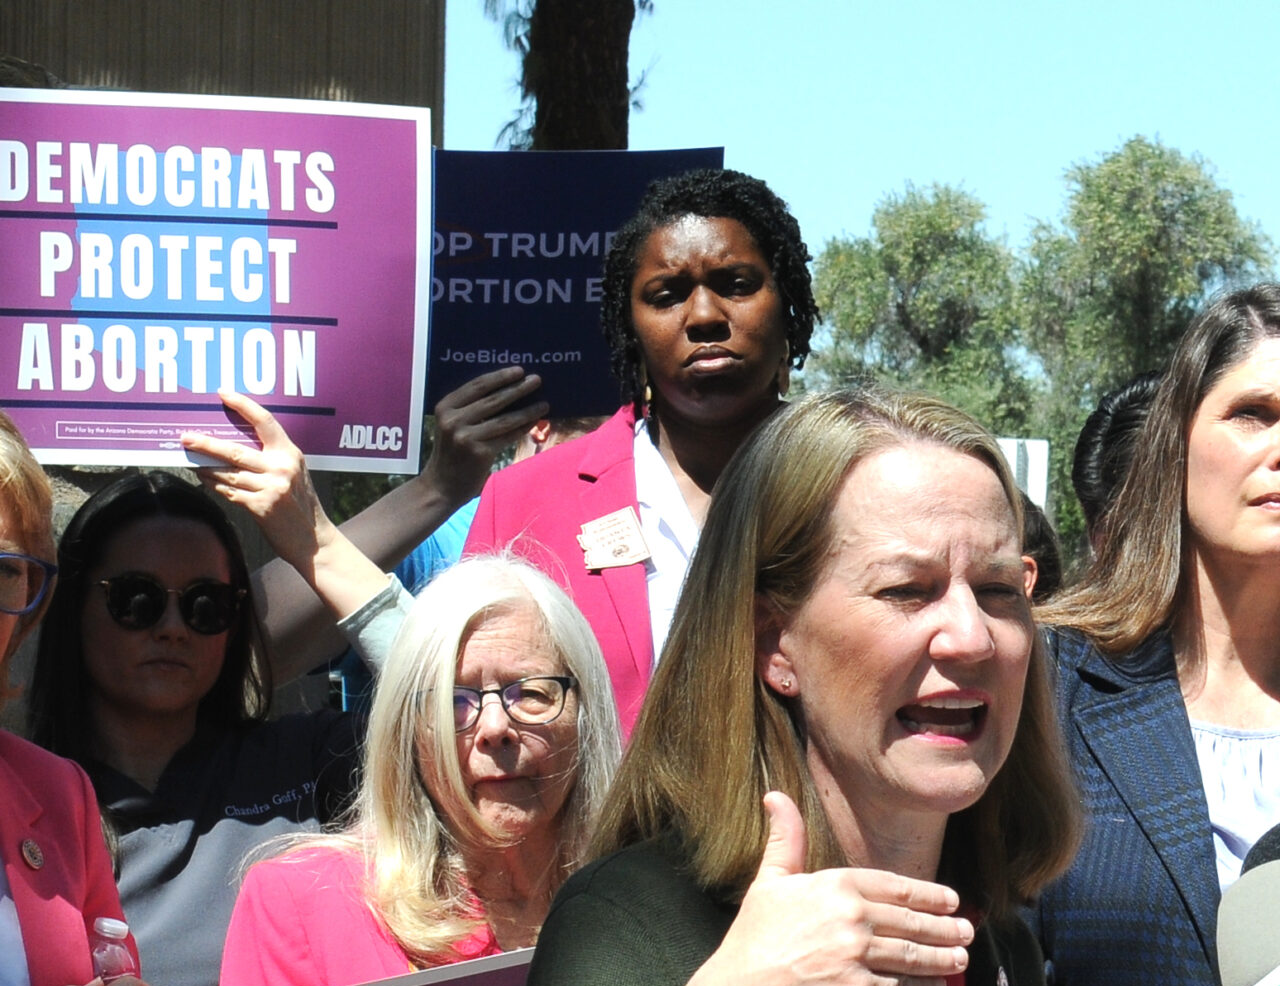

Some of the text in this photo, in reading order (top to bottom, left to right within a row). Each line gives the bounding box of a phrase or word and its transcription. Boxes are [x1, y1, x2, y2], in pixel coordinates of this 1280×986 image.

[0, 140, 337, 214] DEMOCRATS
[40, 231, 297, 304] PROTECT
[17, 323, 316, 397] ABORTION
[440, 348, 581, 364] JoeBiden.com
[339, 423, 403, 452] ADLCC
[224, 804, 271, 817] Chandra
